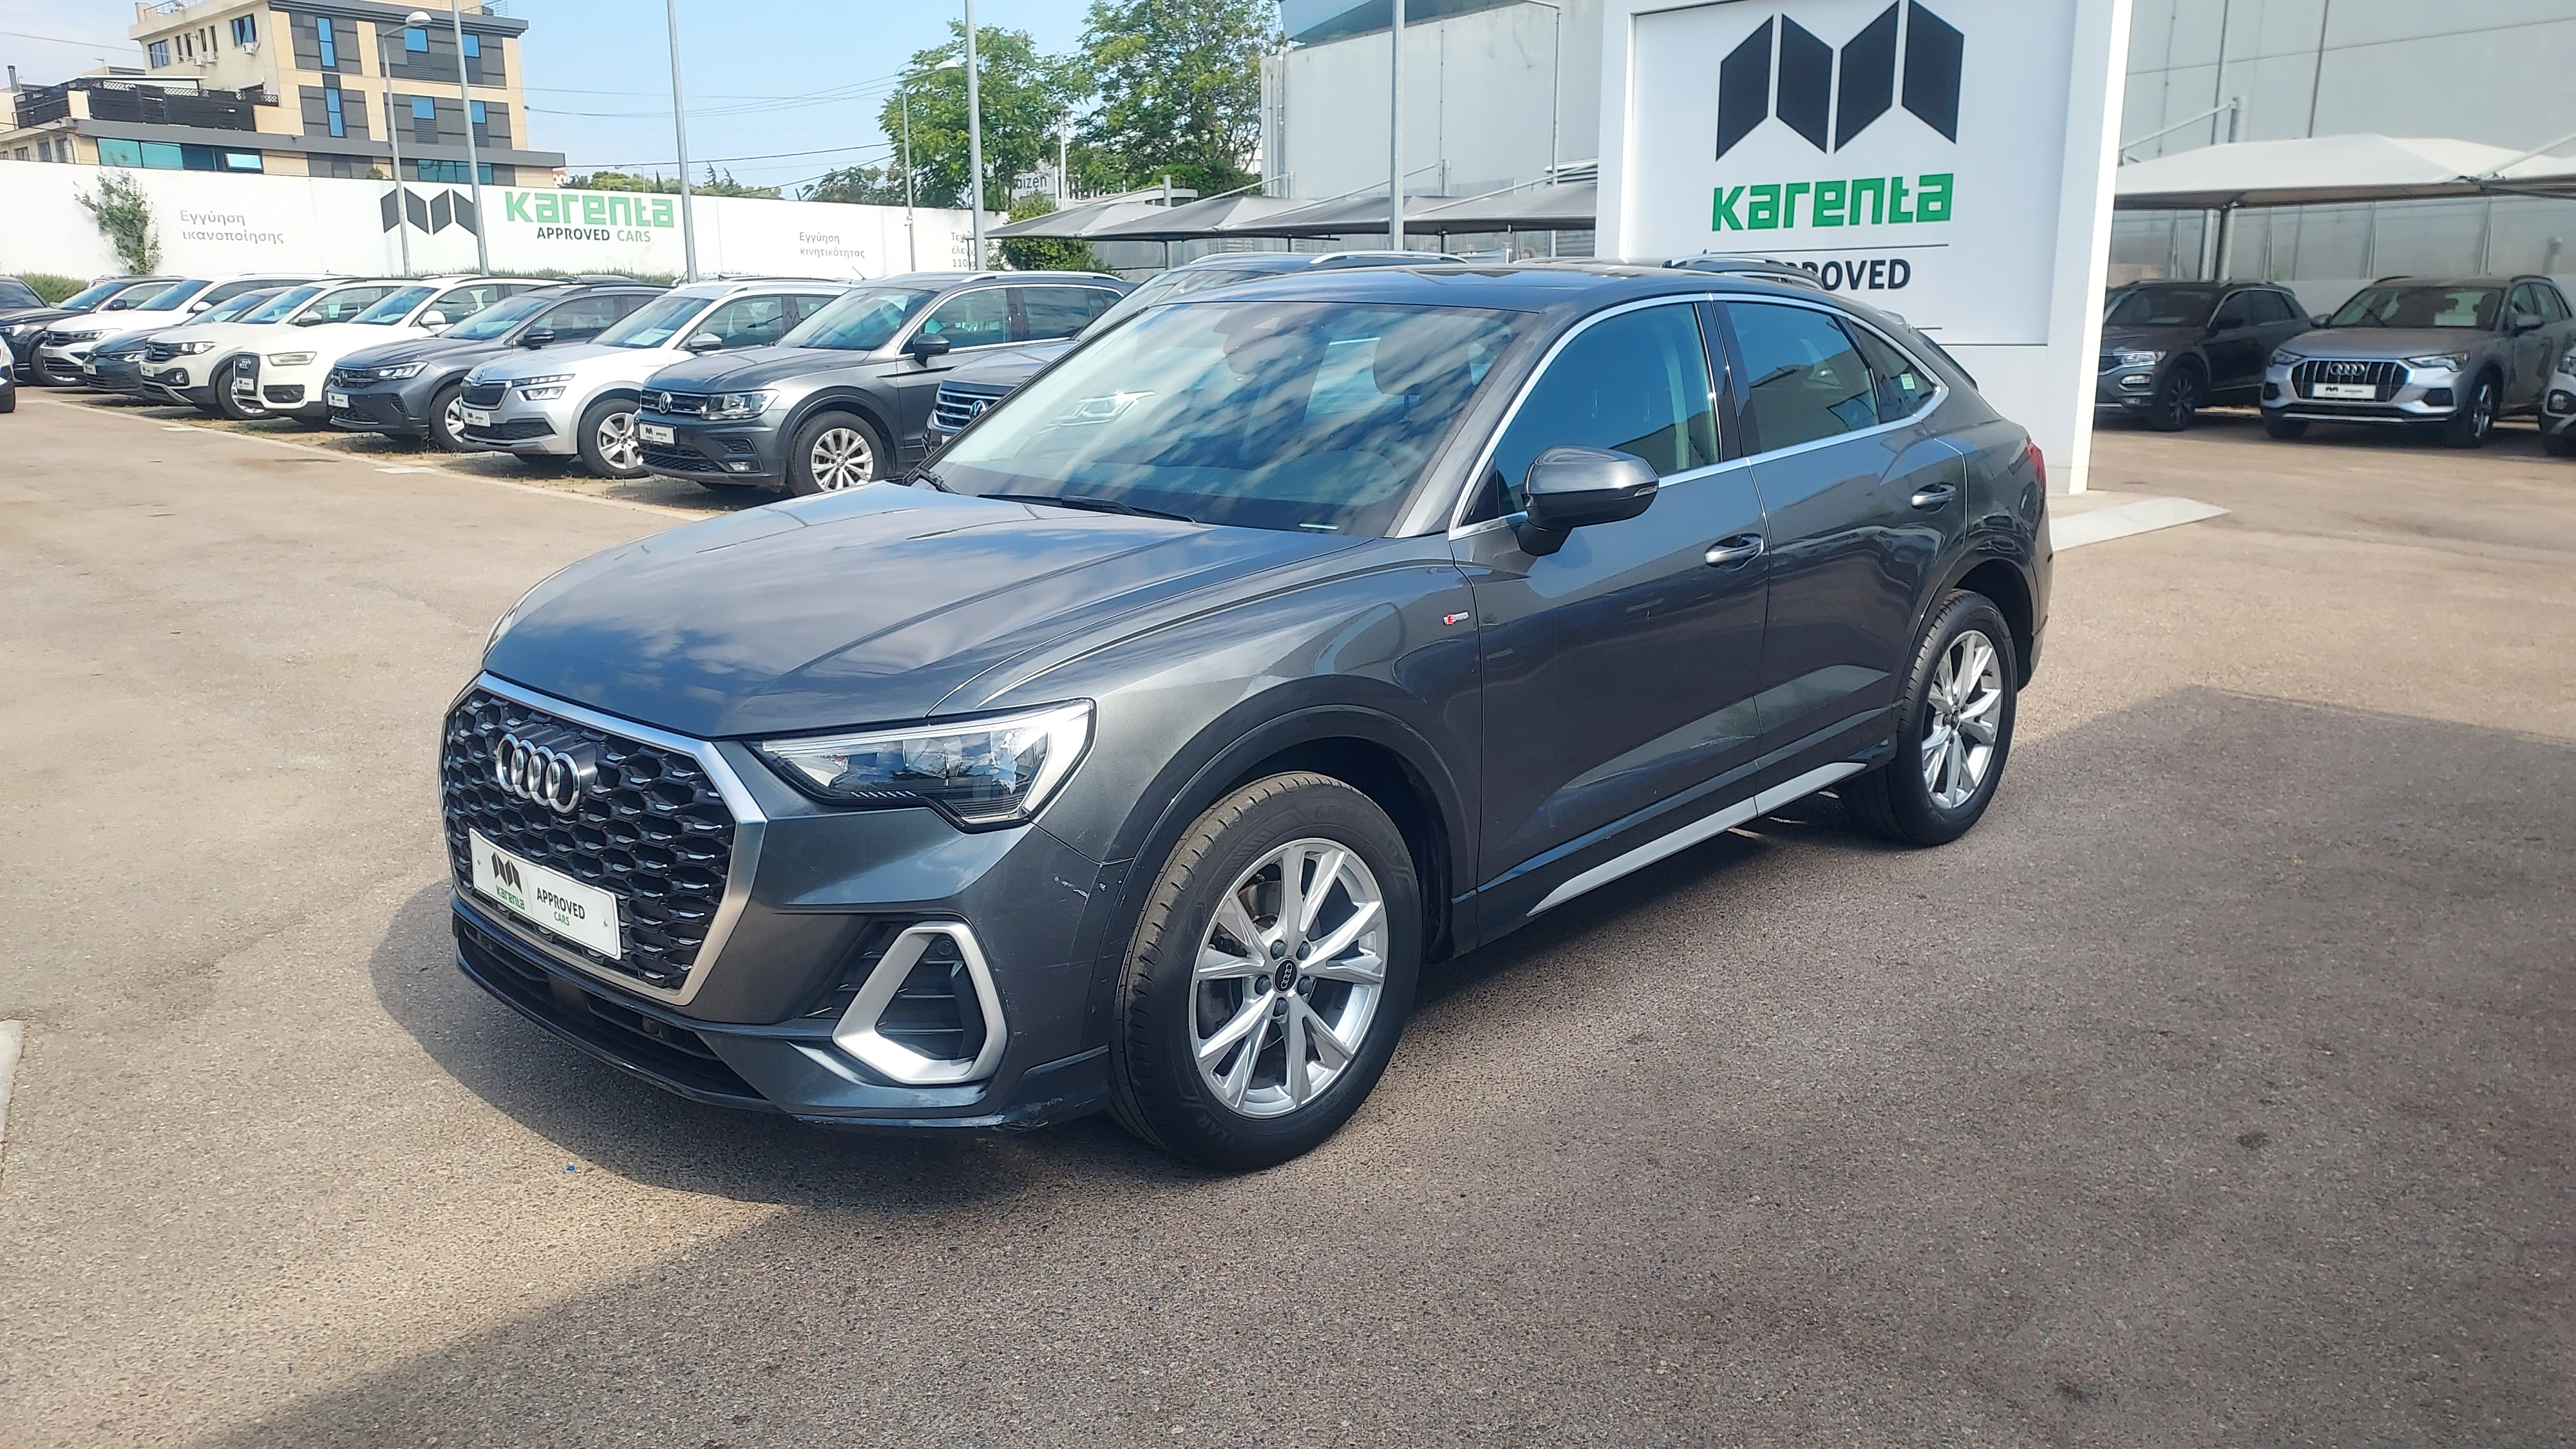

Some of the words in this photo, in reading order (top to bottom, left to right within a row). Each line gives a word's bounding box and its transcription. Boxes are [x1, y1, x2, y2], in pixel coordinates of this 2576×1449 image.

[180, 210, 245, 226] Εγγύηση
[182, 229, 284, 244] ικανοποίησης
[536, 227, 610, 241] APPROVED
[617, 230, 650, 242] CARS
[799, 232, 840, 244] Εγγύηση
[800, 247, 864, 259] κινητικότητας
[952, 259, 968, 267] 110
[536, 887, 585, 920] APPROVED
[554, 911, 570, 926] CARS
